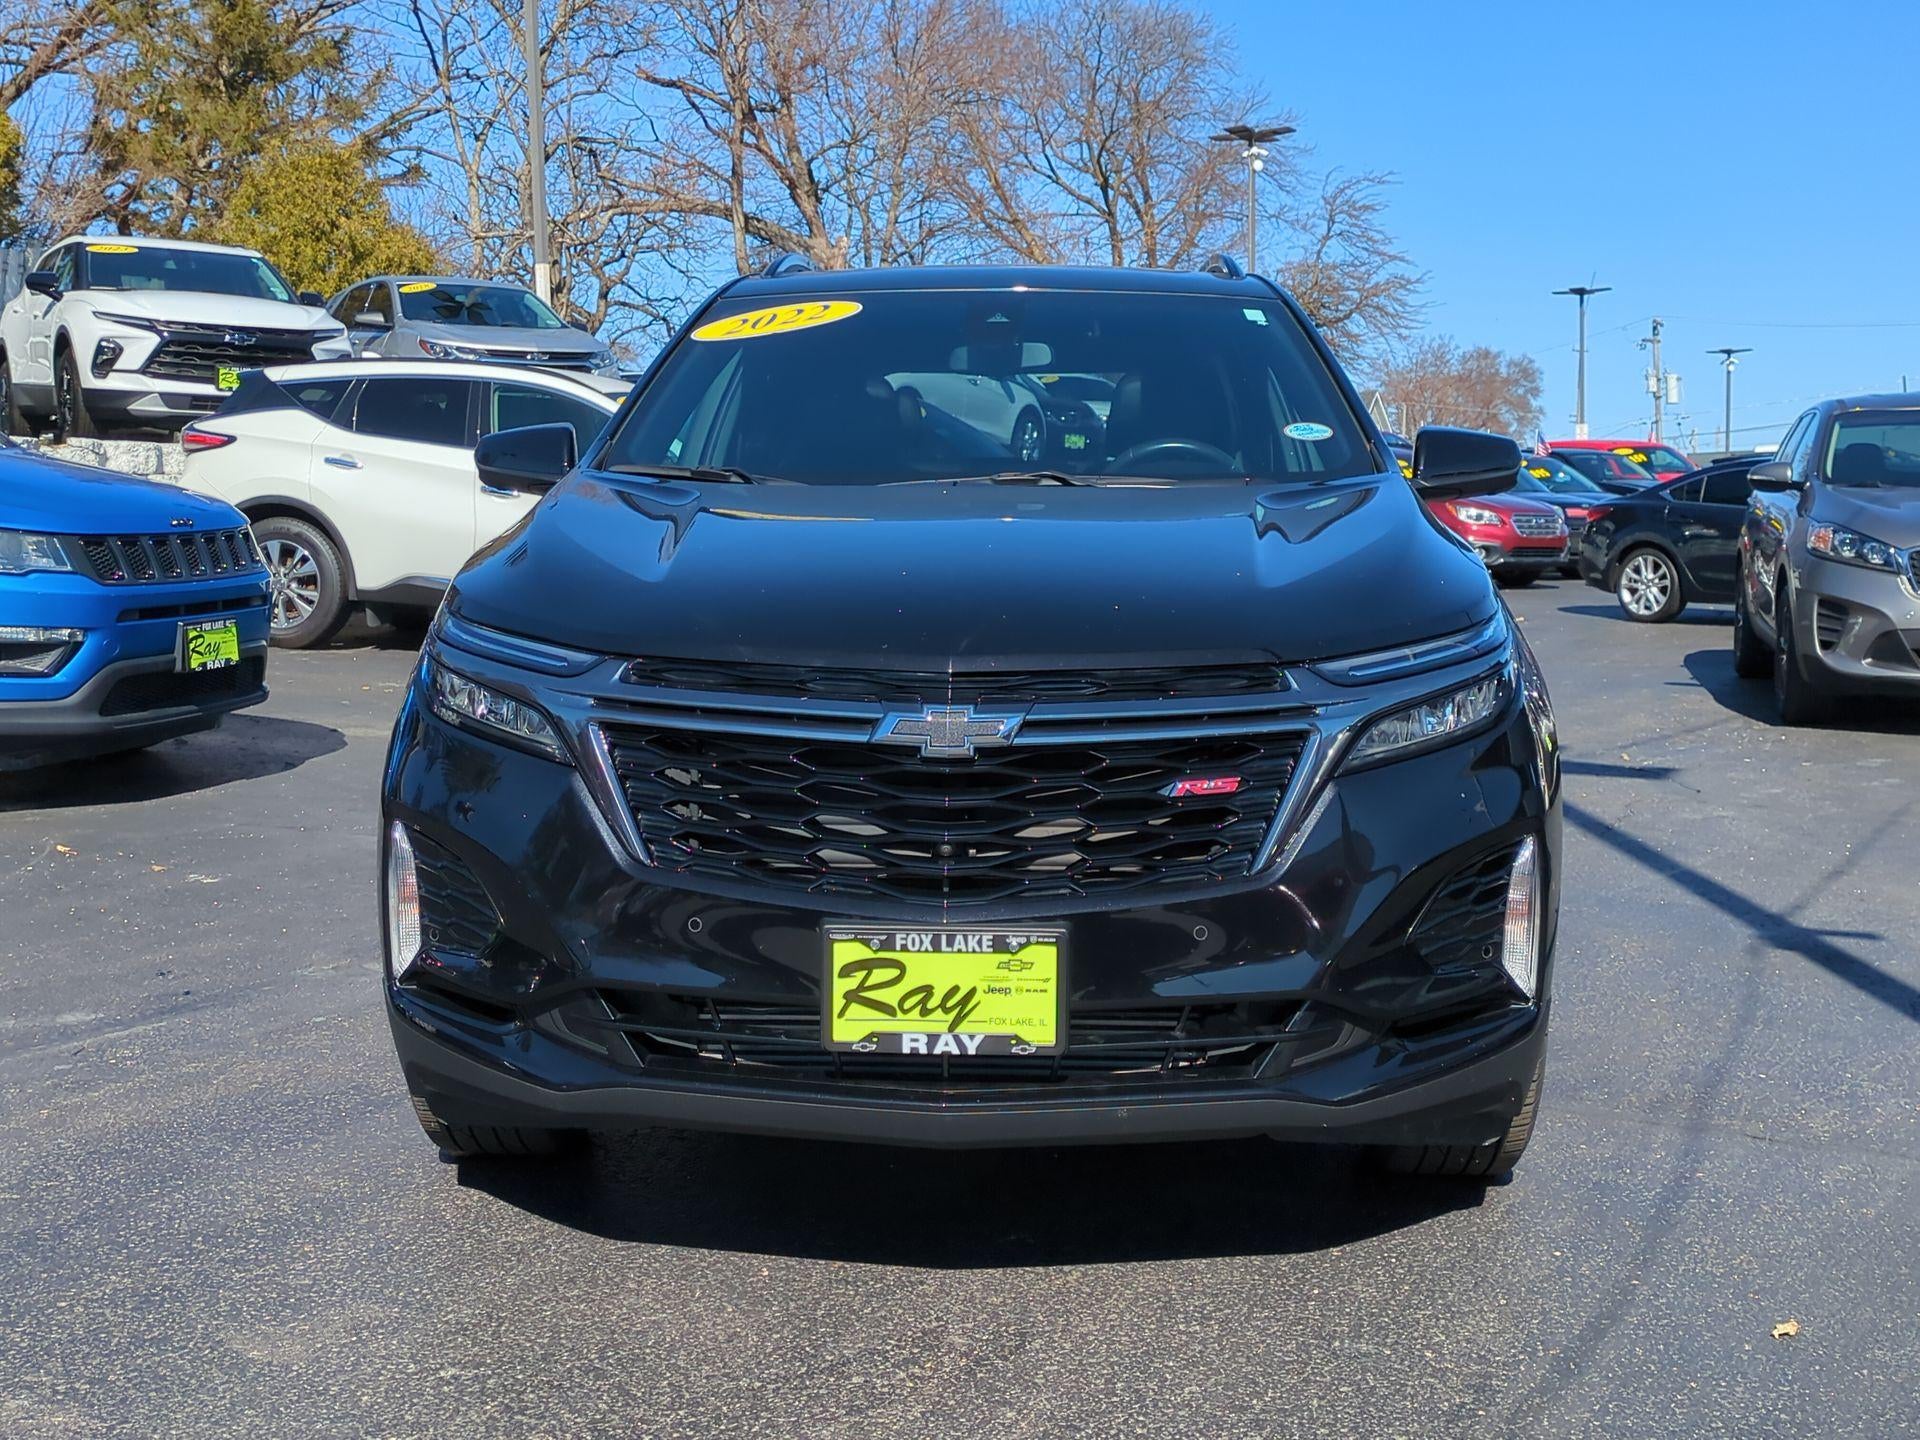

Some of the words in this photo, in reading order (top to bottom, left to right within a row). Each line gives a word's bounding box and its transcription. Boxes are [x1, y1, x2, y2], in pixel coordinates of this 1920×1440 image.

[721, 304, 831, 336] 2022
[188, 633, 220, 661] Ray
[207, 659, 225, 670] RAY
[895, 933, 934, 952] FOX
[941, 934, 994, 953] LAKE
[837, 957, 981, 1033] Ray
[983, 984, 1013, 996] Jeep
[988, 1016, 1008, 1027] FOX
[1009, 1016, 1037, 1028] LAKE,
[1039, 1016, 1048, 1027] IL
[901, 1033, 986, 1056] RAY
